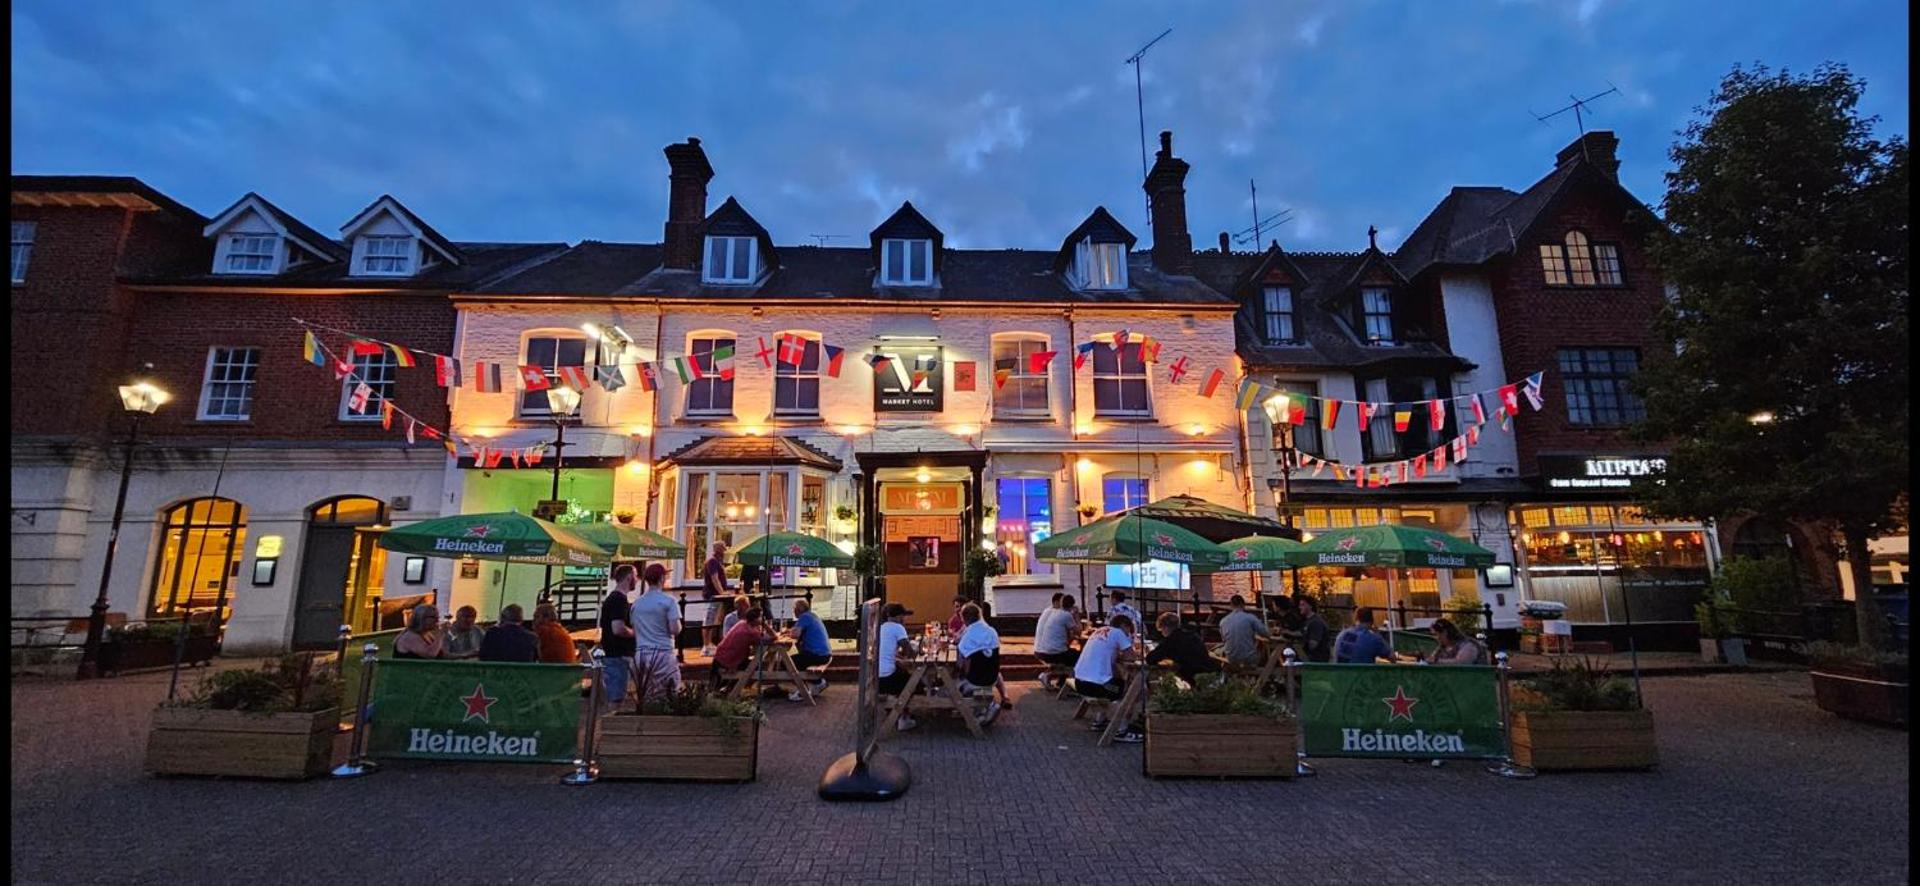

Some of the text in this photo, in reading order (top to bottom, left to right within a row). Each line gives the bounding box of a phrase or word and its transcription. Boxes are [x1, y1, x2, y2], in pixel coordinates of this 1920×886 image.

[435, 538, 504, 553] Heineken
[1056, 549, 1089, 558] Heineken
[1147, 546, 1193, 562] Heineken
[1318, 552, 1365, 563] Heineken
[1427, 553, 1465, 566] Heineken
[772, 555, 820, 567] Heineken
[407, 727, 538, 755] Heineken
[1341, 728, 1465, 752] Heineken
